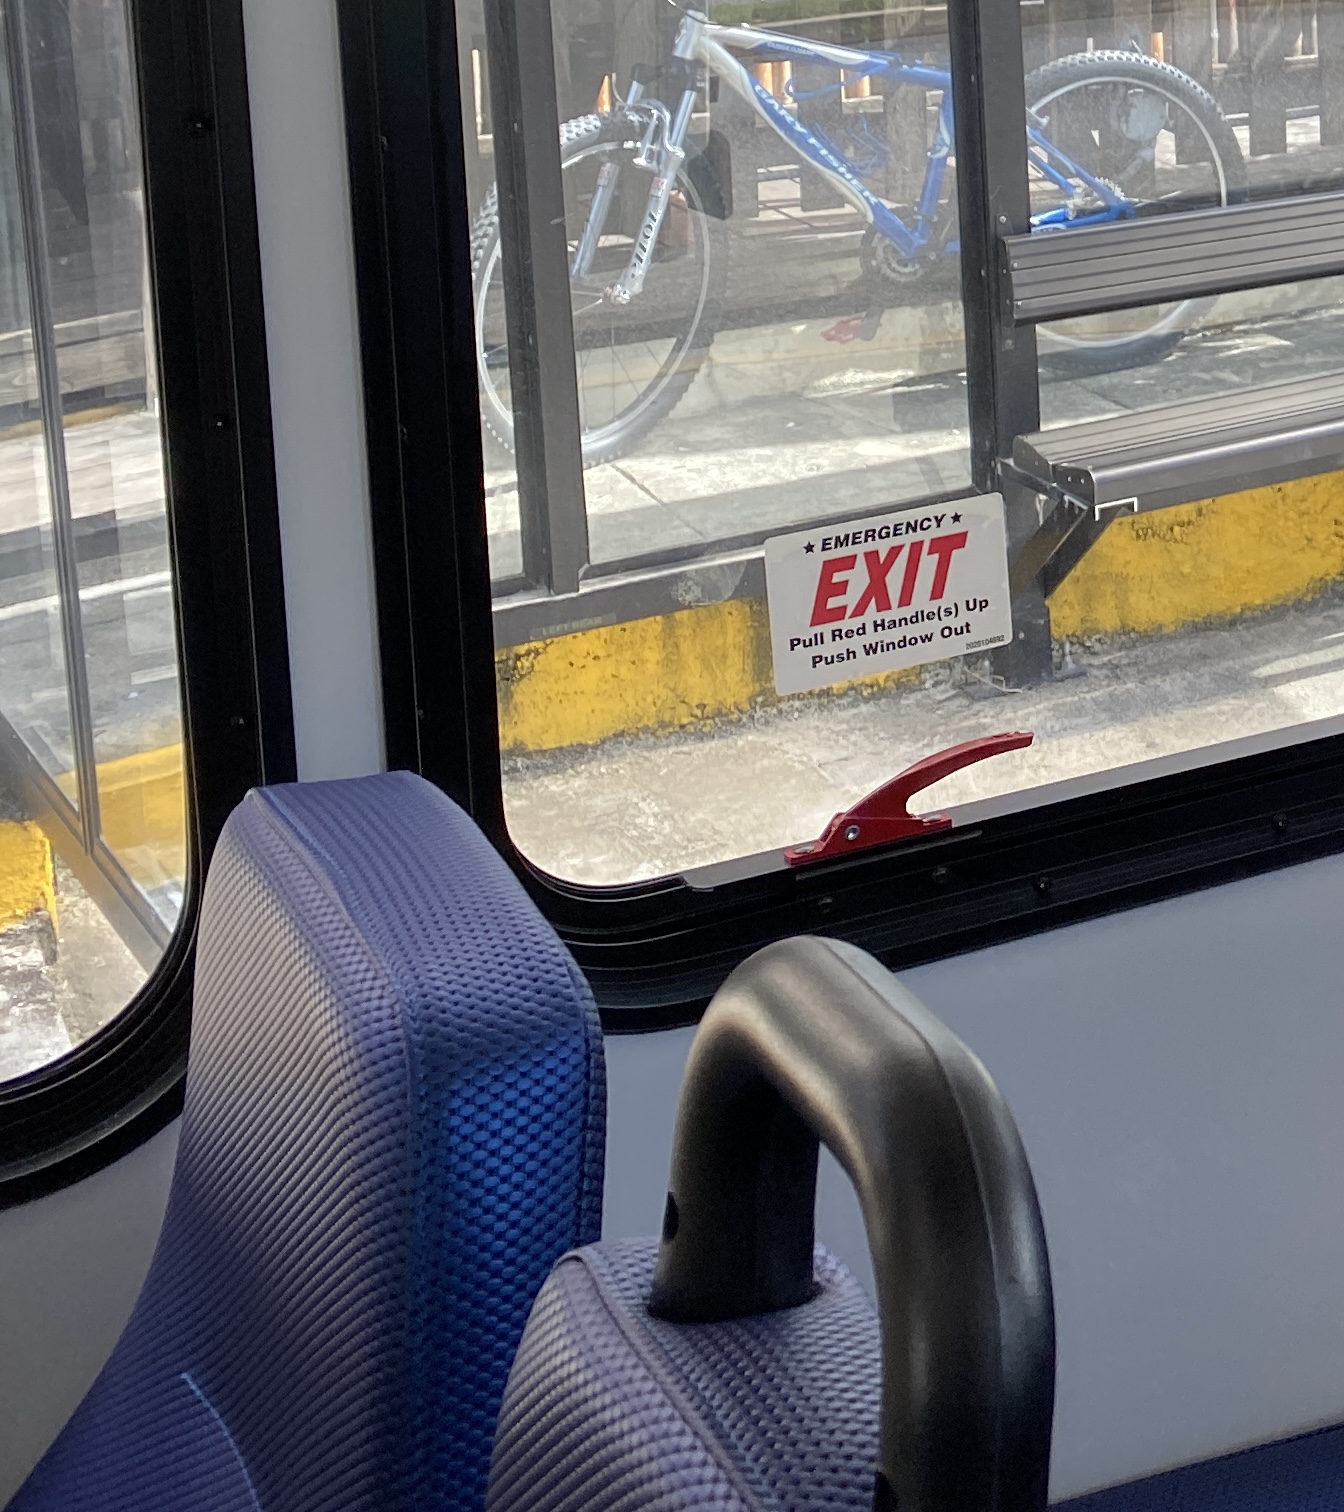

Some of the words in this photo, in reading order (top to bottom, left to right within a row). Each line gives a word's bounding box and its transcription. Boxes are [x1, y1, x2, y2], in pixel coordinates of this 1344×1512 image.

[807, 137, 878, 205] FISHER
[820, 513, 947, 552] EMERGENCY
[808, 530, 969, 628] EXIT
[789, 631, 825, 652] Pull
[830, 622, 867, 643] Red
[872, 602, 960, 634] Handle(s)
[964, 597, 990, 614] Up
[811, 647, 857, 669] Push
[862, 631, 935, 657] Window
[939, 621, 972, 639] Out
